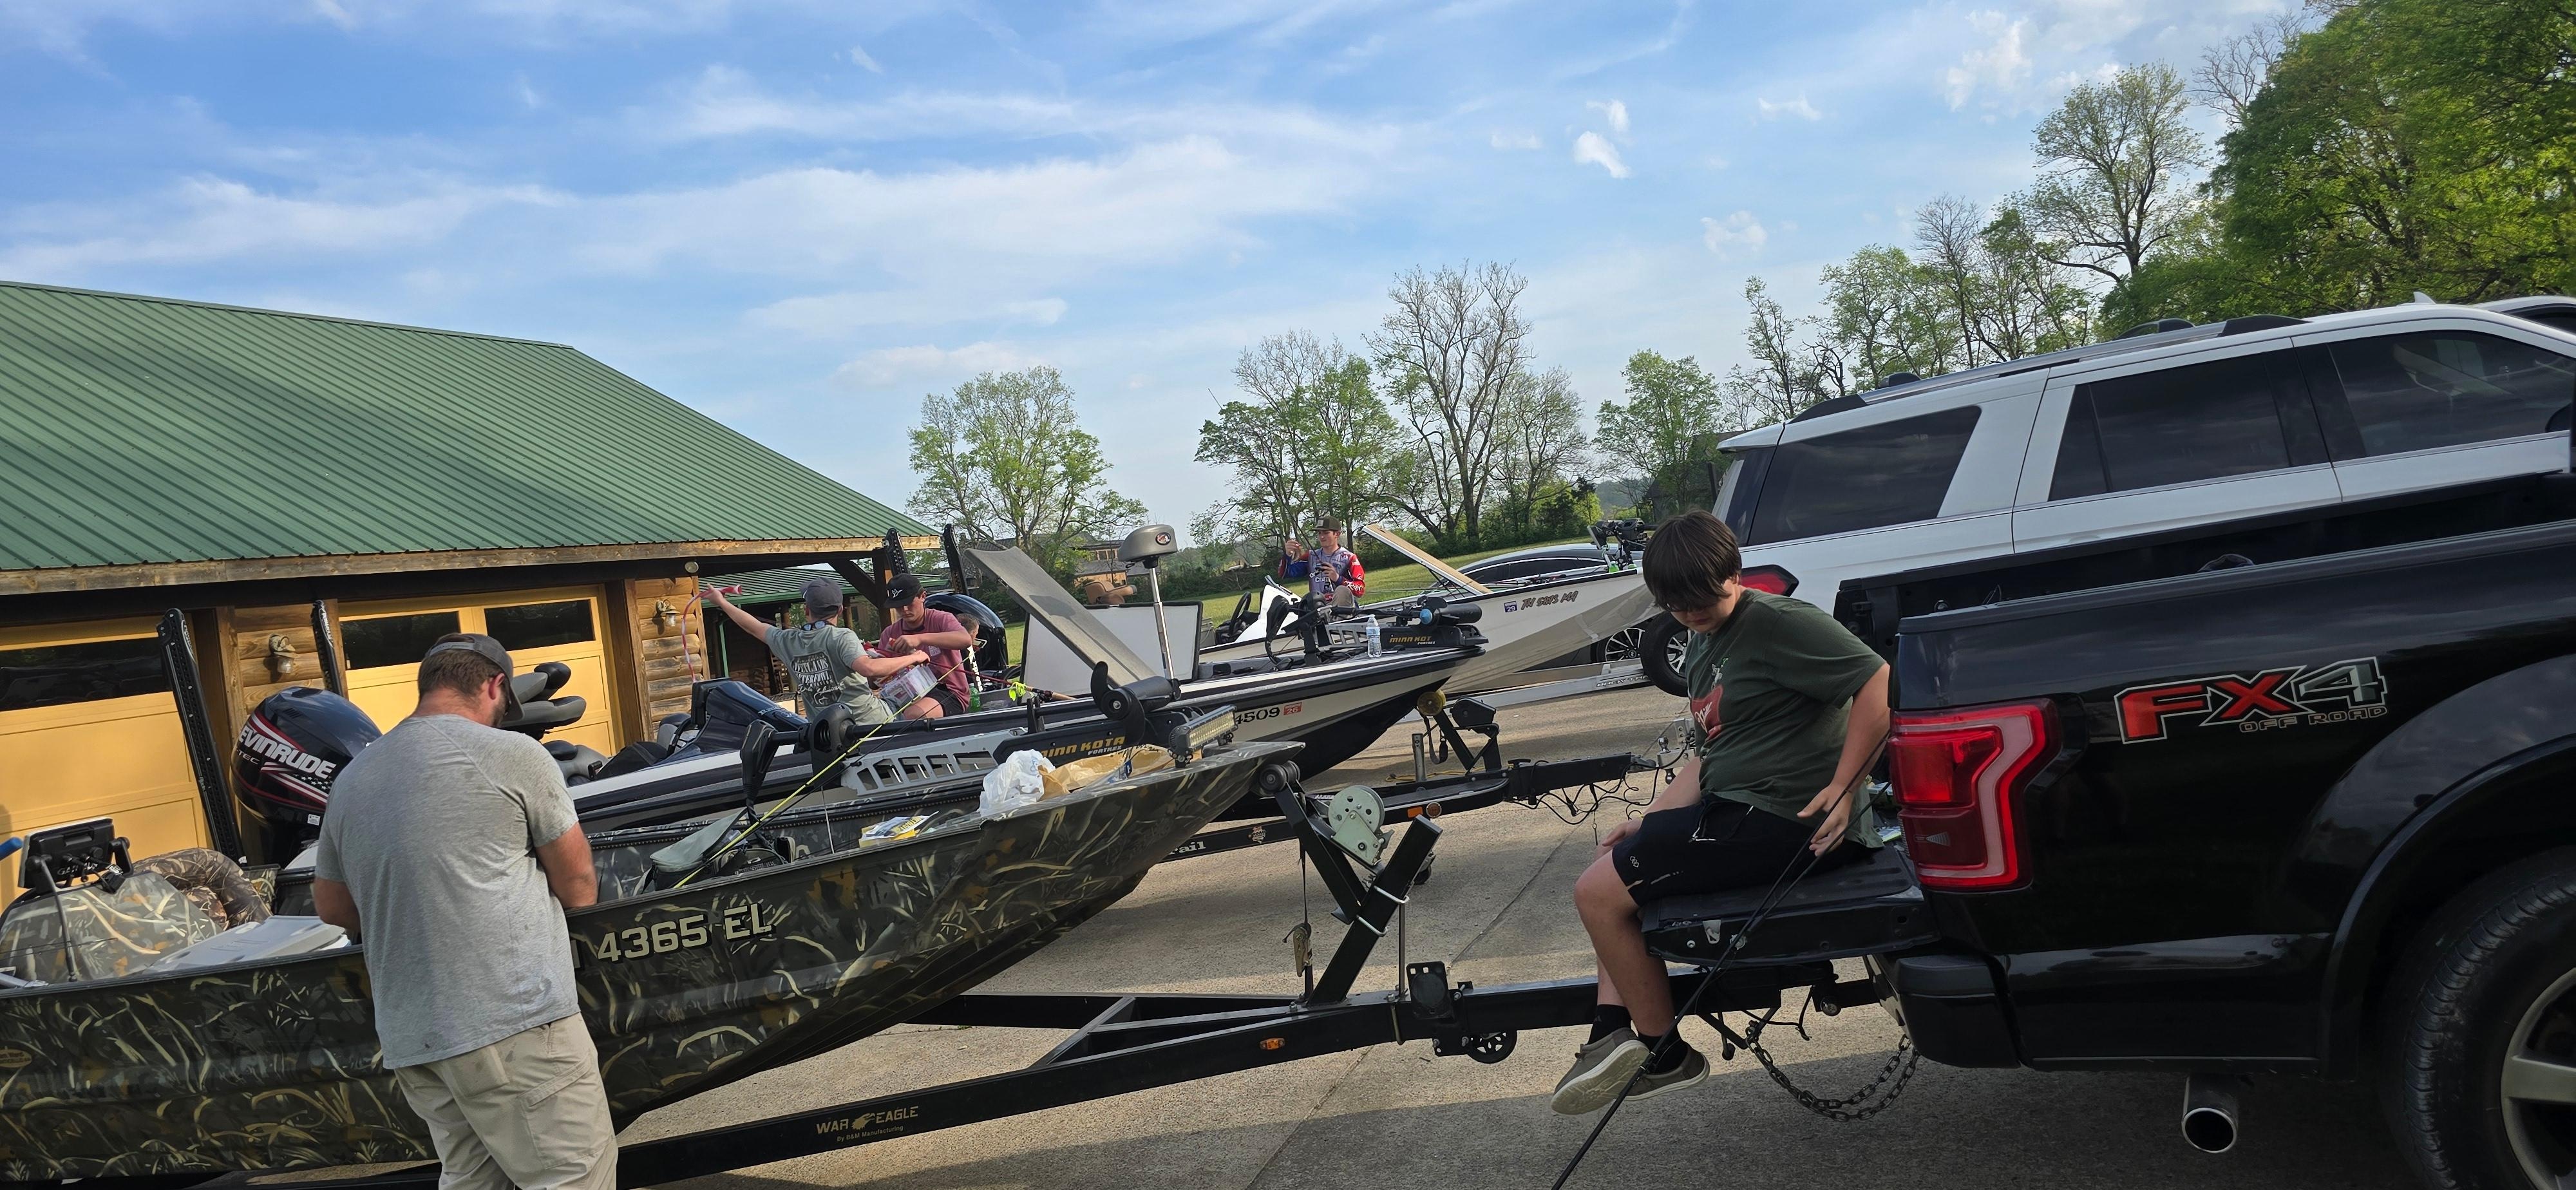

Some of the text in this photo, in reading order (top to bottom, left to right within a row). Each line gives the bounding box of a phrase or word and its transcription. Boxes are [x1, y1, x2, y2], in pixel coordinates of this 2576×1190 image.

[1521, 597, 1536, 610] TN
[1627, 674, 1649, 683] TRA
[2114, 656, 2387, 744] FX4
[1235, 707, 1280, 724] 4509
[2239, 706, 2388, 733] OFF ROAD
[1080, 736, 1125, 751] KOTA
[1087, 745, 1122, 755] FORTREX
[239, 725, 336, 779] EVINRUDE
[1169, 841, 1206, 855] rail
[598, 914, 708, 962] 4365
[723, 903, 772, 940] EL
[817, 1106, 919, 1134] WAR EAGLE
[862, 1125, 904, 1138] Manufacturing
